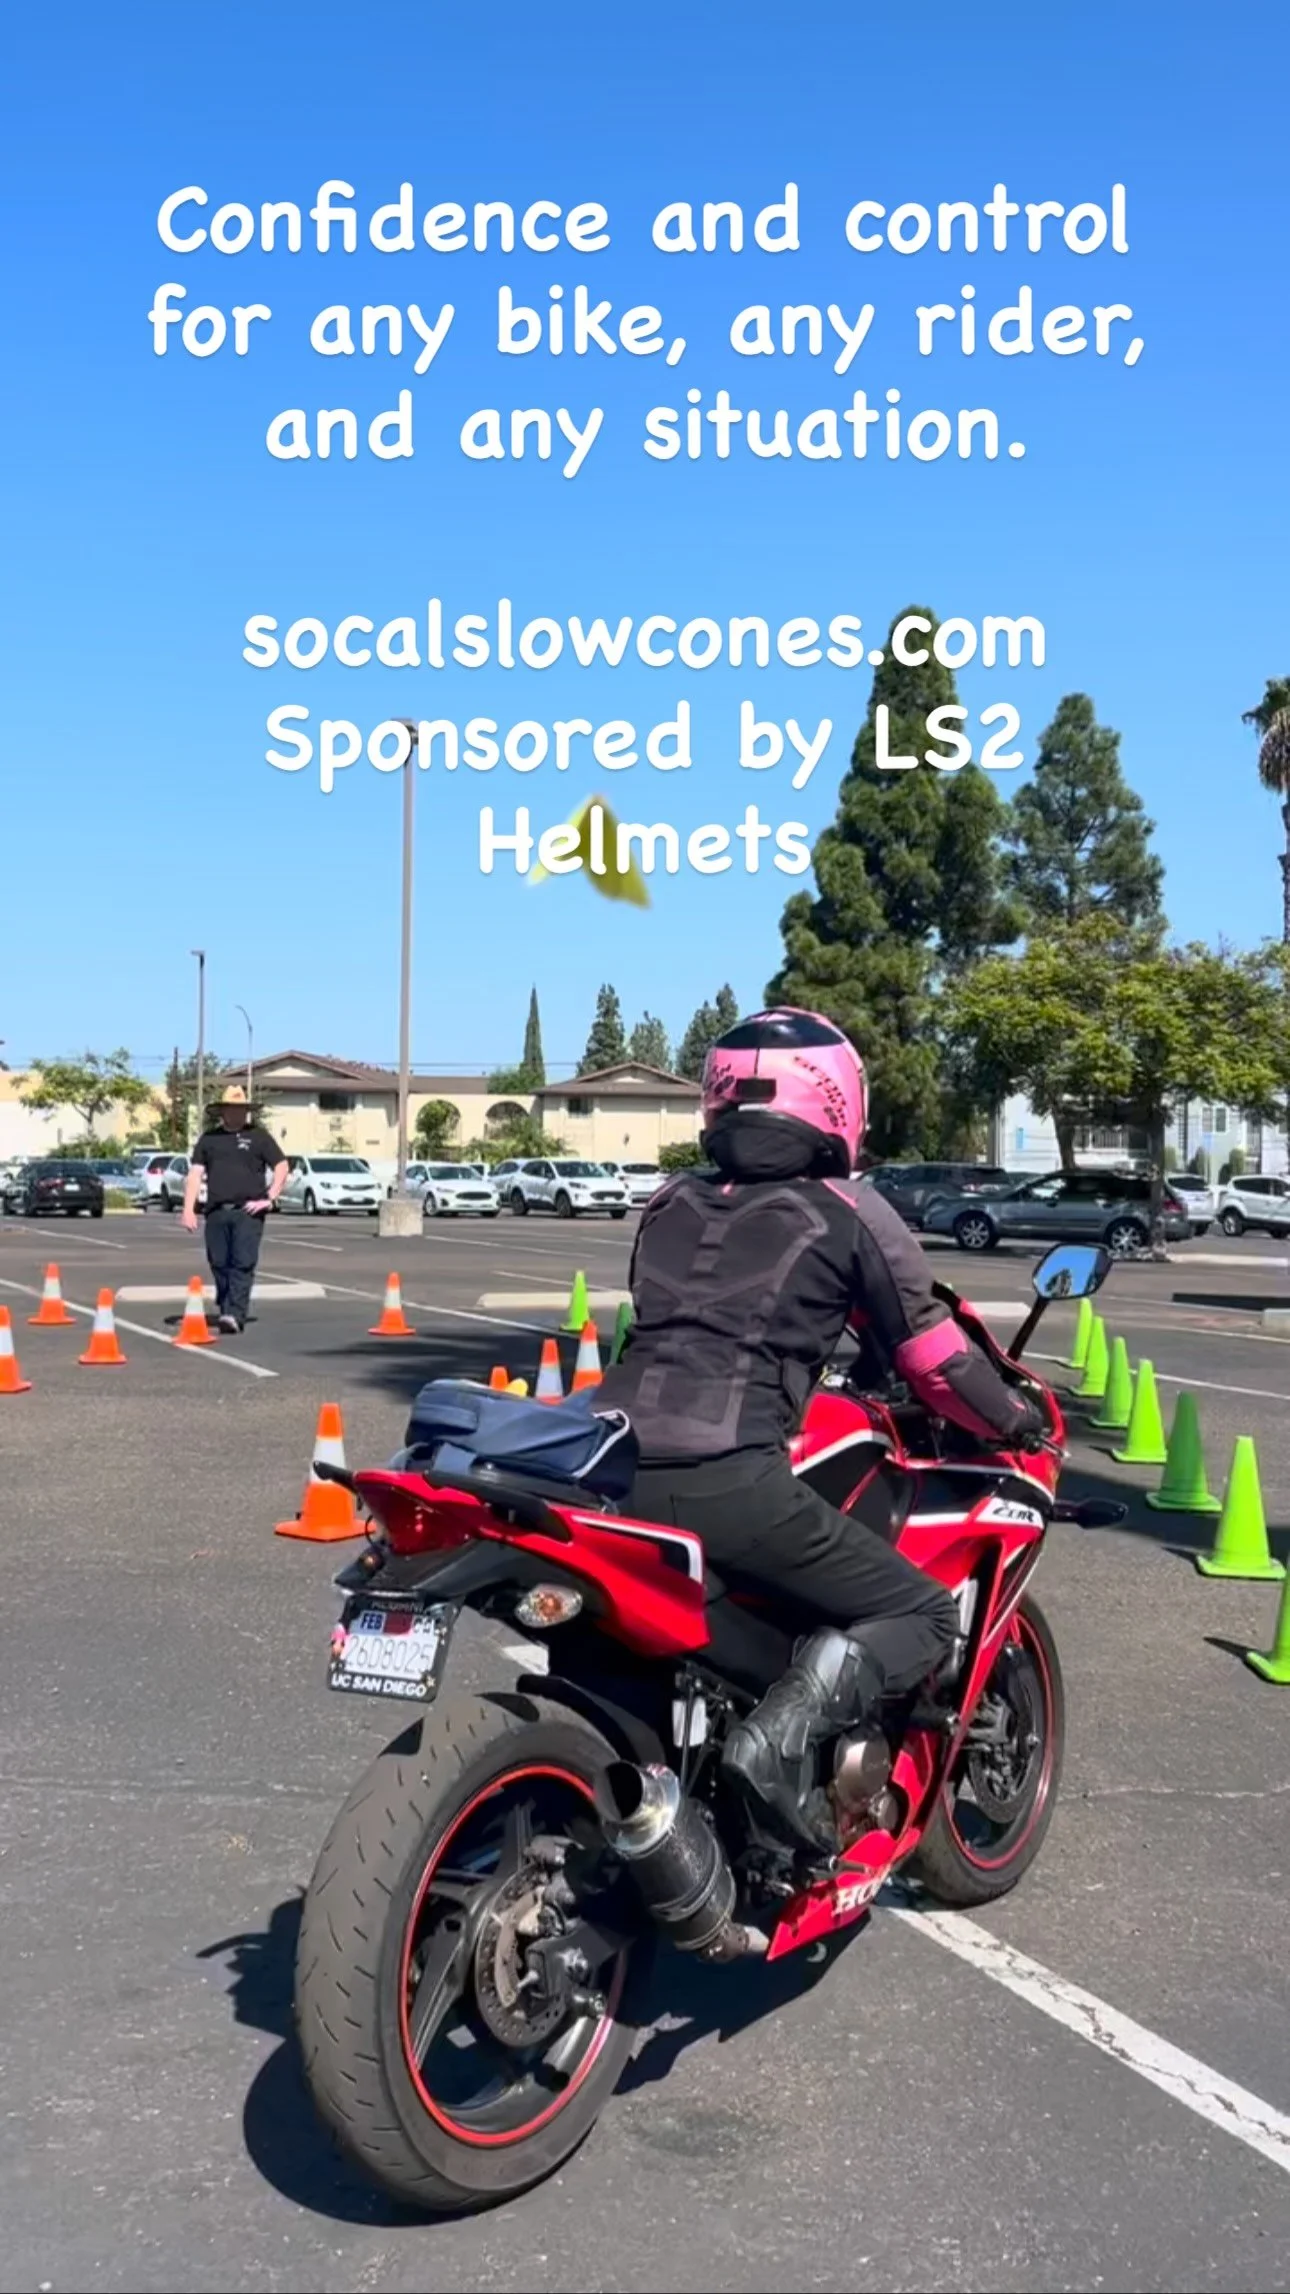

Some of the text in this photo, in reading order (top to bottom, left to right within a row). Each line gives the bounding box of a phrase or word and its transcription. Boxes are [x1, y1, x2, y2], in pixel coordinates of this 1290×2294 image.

[331, 1673, 427, 1697] UC SAN DIEGO
